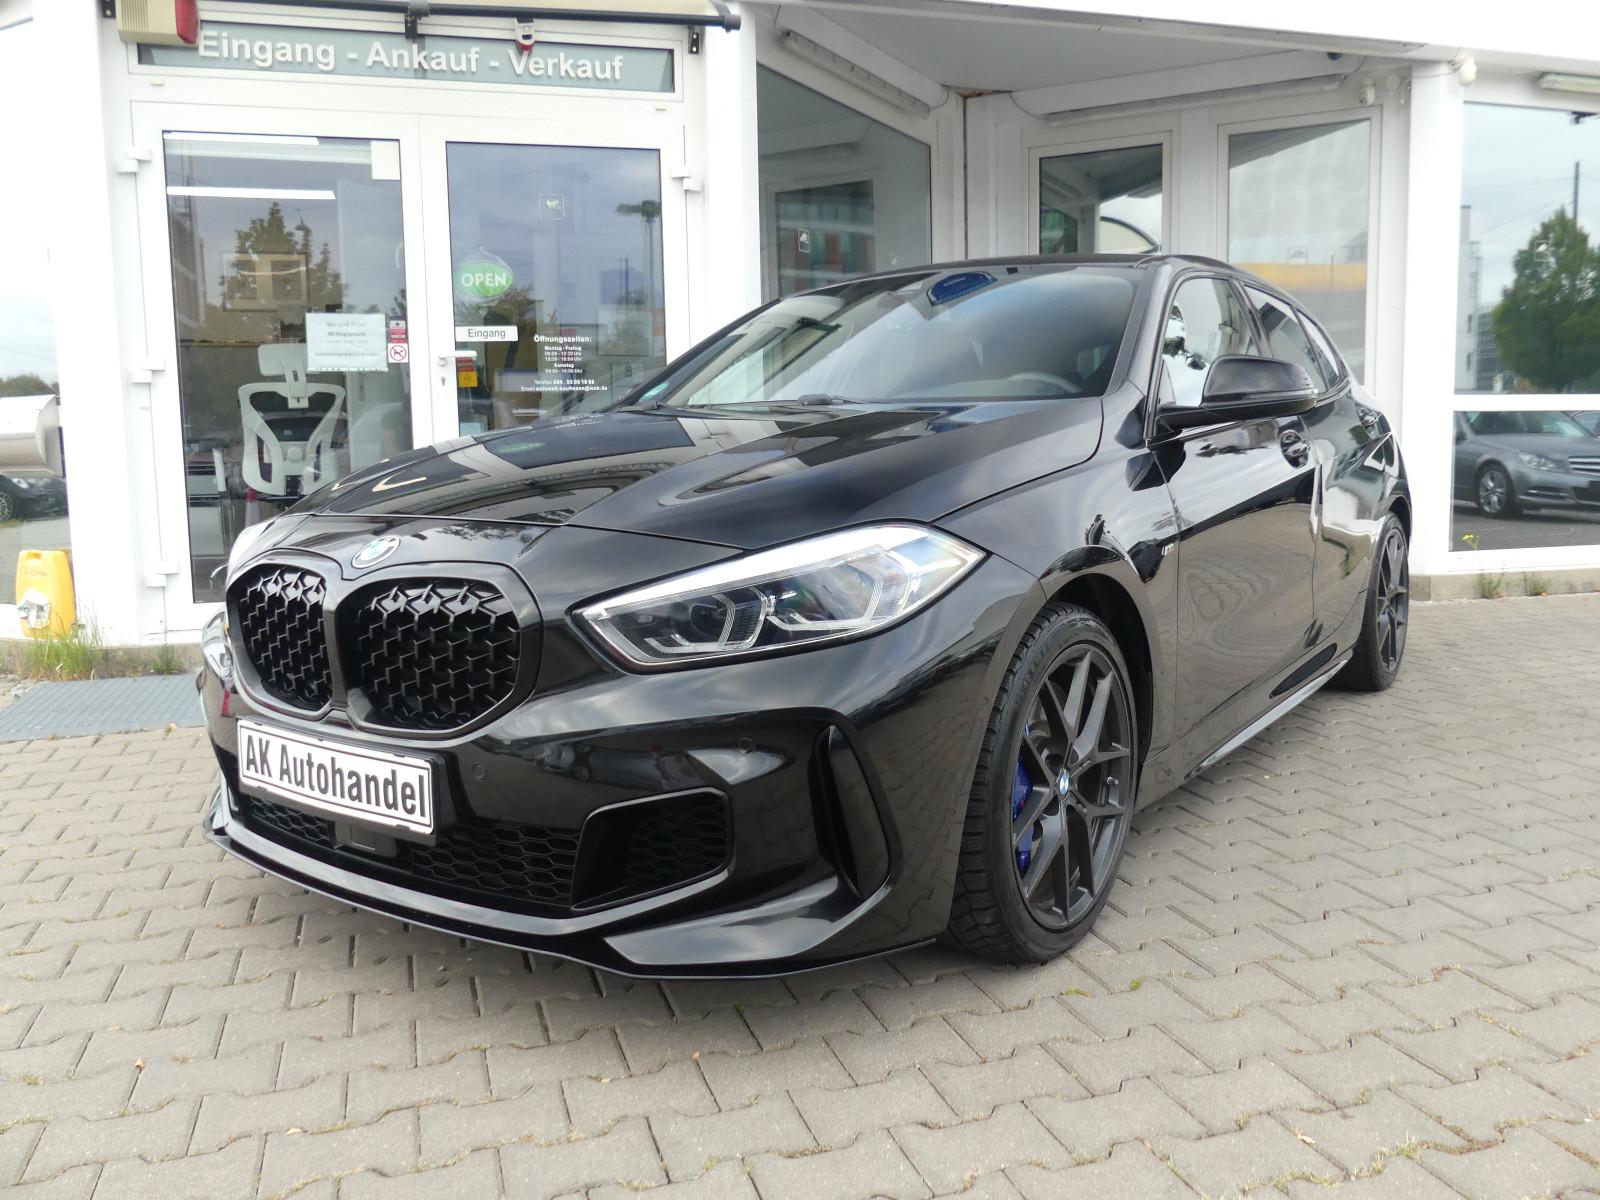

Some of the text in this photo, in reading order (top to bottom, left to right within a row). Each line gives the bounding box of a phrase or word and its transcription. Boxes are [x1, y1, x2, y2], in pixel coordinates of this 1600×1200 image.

[199, 31, 336, 71] Eingang
[366, 41, 480, 73] Ankauf
[508, 49, 624, 80] Verkauf
[460, 273, 507, 288] OPEN
[467, 328, 506, 340] Eingang
[533, 334, 592, 344] Öffnungszeiten:
[246, 734, 426, 817] AK Autohandel
